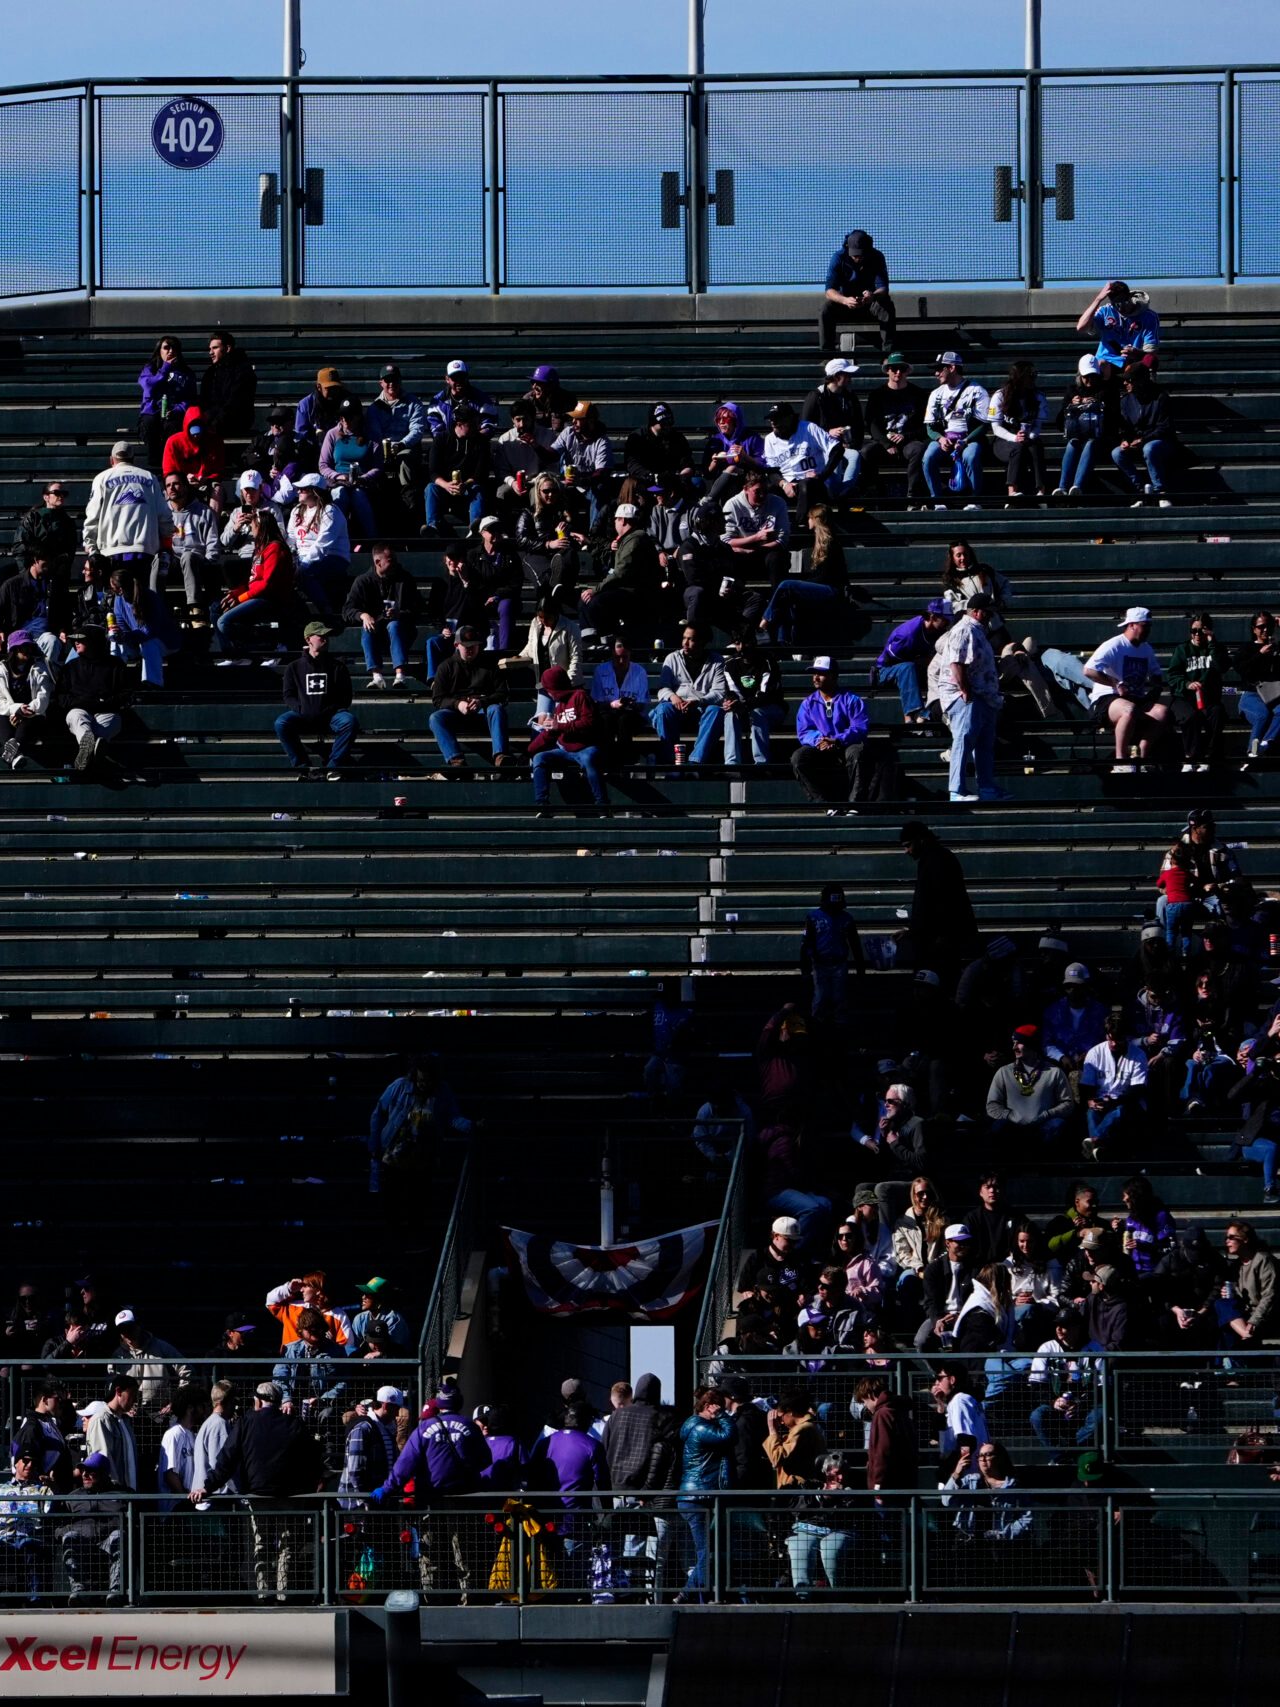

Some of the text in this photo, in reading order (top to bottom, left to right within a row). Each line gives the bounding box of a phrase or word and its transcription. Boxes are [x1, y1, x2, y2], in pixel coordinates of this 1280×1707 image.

[170, 102, 205, 114] SECTION
[160, 117, 215, 152] 402
[800, 457, 816, 471] 00
[105, 475, 152, 489] COLORADO
[107, 1635, 248, 1681] Energy
